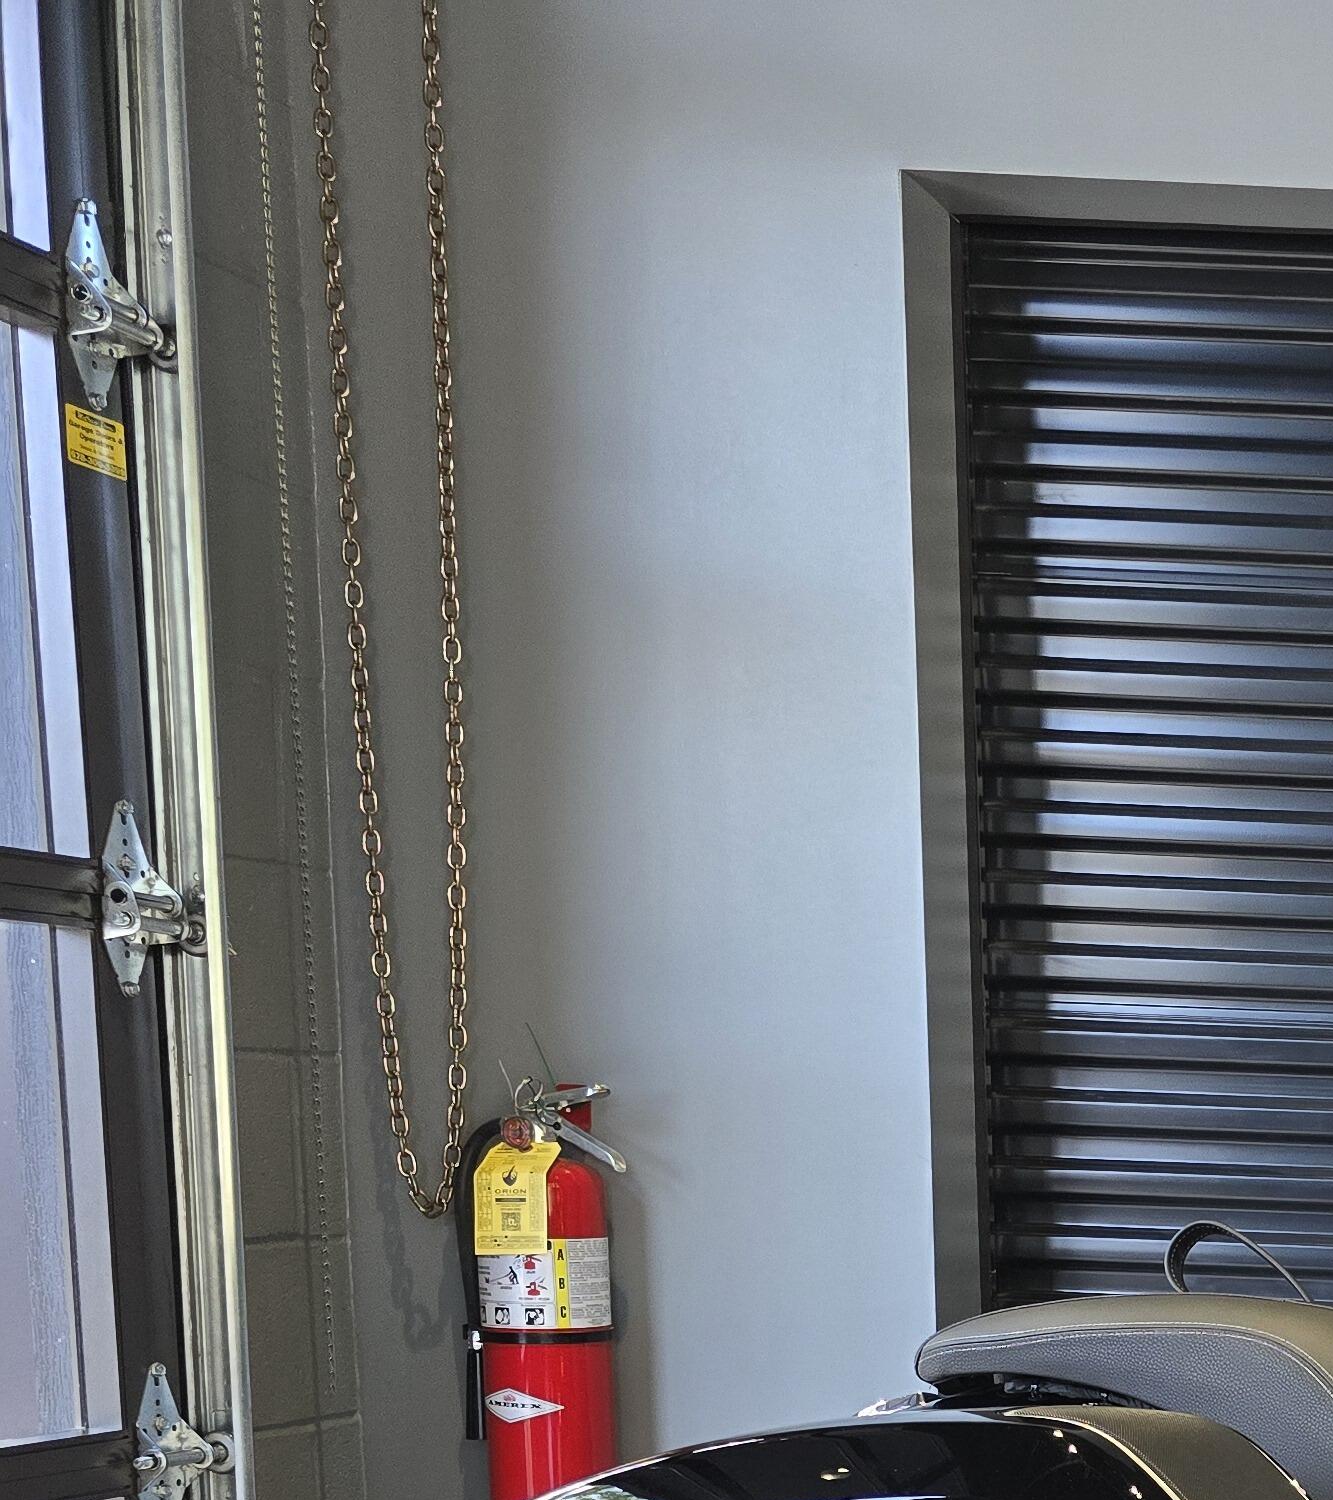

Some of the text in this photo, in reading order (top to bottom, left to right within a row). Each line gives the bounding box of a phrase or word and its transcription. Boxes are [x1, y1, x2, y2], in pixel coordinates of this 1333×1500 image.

[557, 1248, 565, 1261] A
[558, 1277, 565, 1290] B
[560, 1306, 567, 1319] C
[489, 1399, 542, 1410] AMEREX
